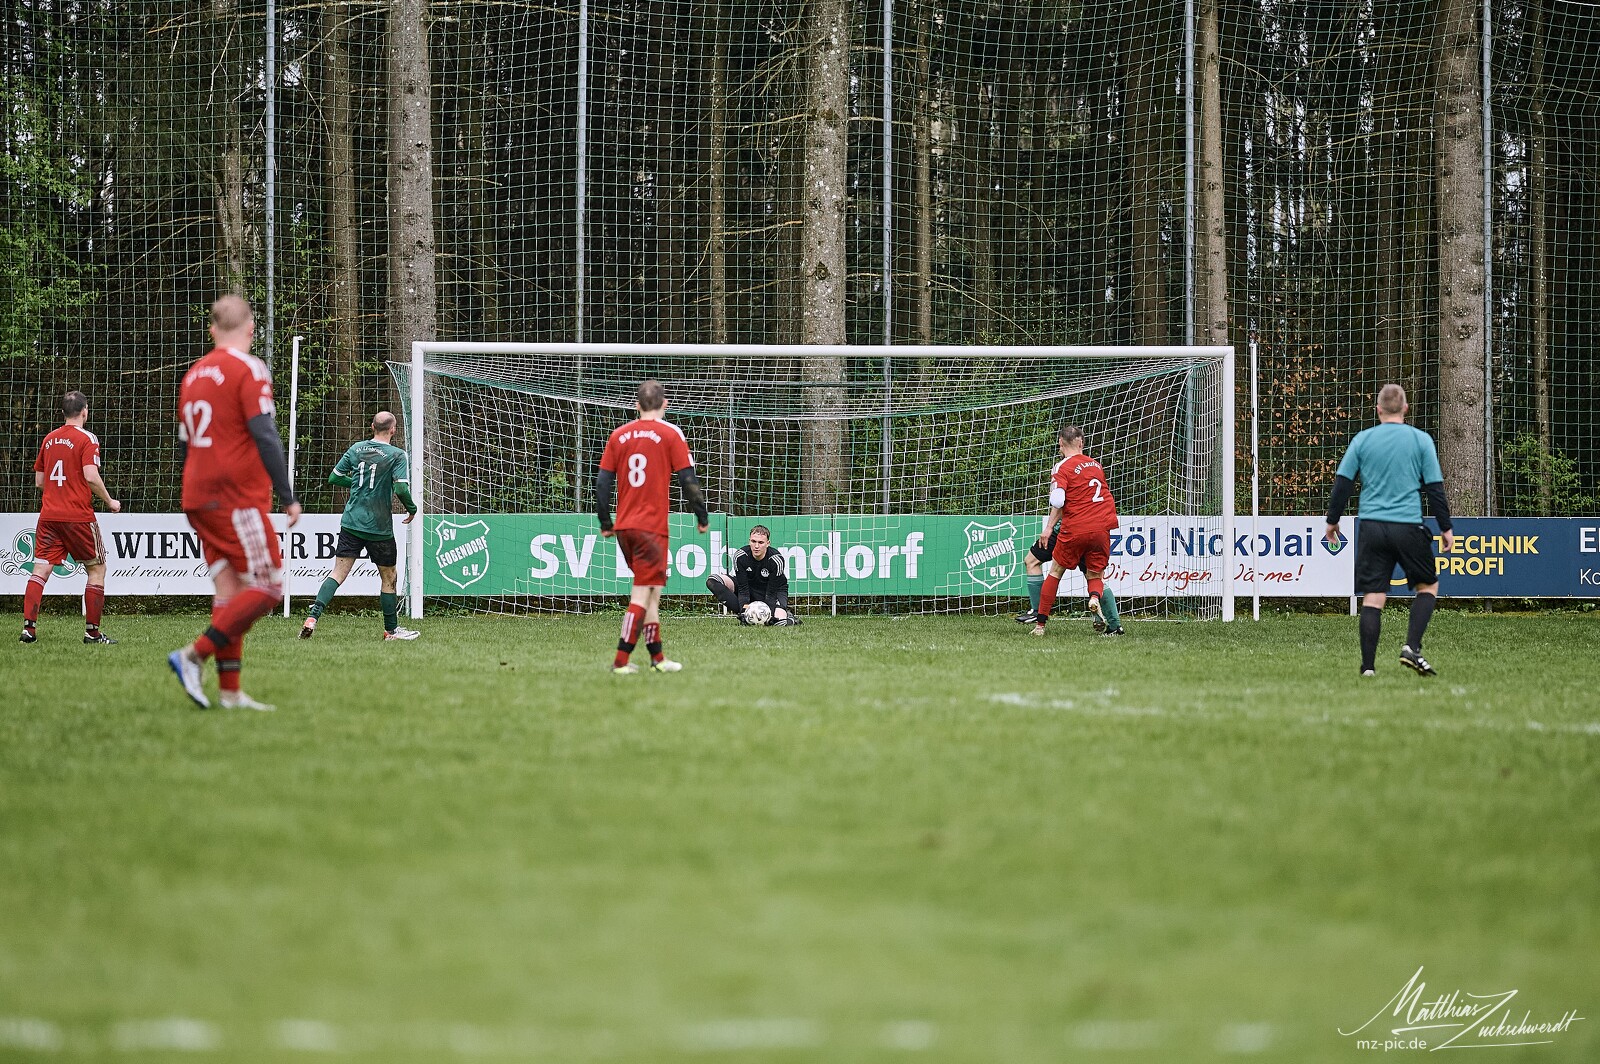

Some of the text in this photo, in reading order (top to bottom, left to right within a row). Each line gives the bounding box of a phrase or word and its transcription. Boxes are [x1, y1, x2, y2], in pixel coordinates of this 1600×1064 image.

[183, 399, 213, 448] 12
[45, 437, 74, 450] SV Laufen
[619, 431, 631, 444] SV
[49, 459, 67, 487] 4
[357, 461, 378, 489] 11
[628, 453, 647, 488] 8
[1074, 464, 1082, 475] SV
[1088, 478, 1104, 503] 2
[443, 528, 457, 541] SV
[971, 529, 985, 542] SV
[1171, 526, 1313, 557] Nickolai
[1432, 535, 1540, 555] TECHNIK
[436, 535, 488, 569] LEOBENDORF
[530, 530, 925, 580] SV Lobndorf
[963, 537, 1015, 570] LEOBENDORF
[111, 565, 140, 578] mit
[139, 566, 188, 578] reinem
[989, 564, 1008, 577] e.V.
[1139, 562, 1212, 590] bringen
[1434, 556, 1505, 576] PROFI
